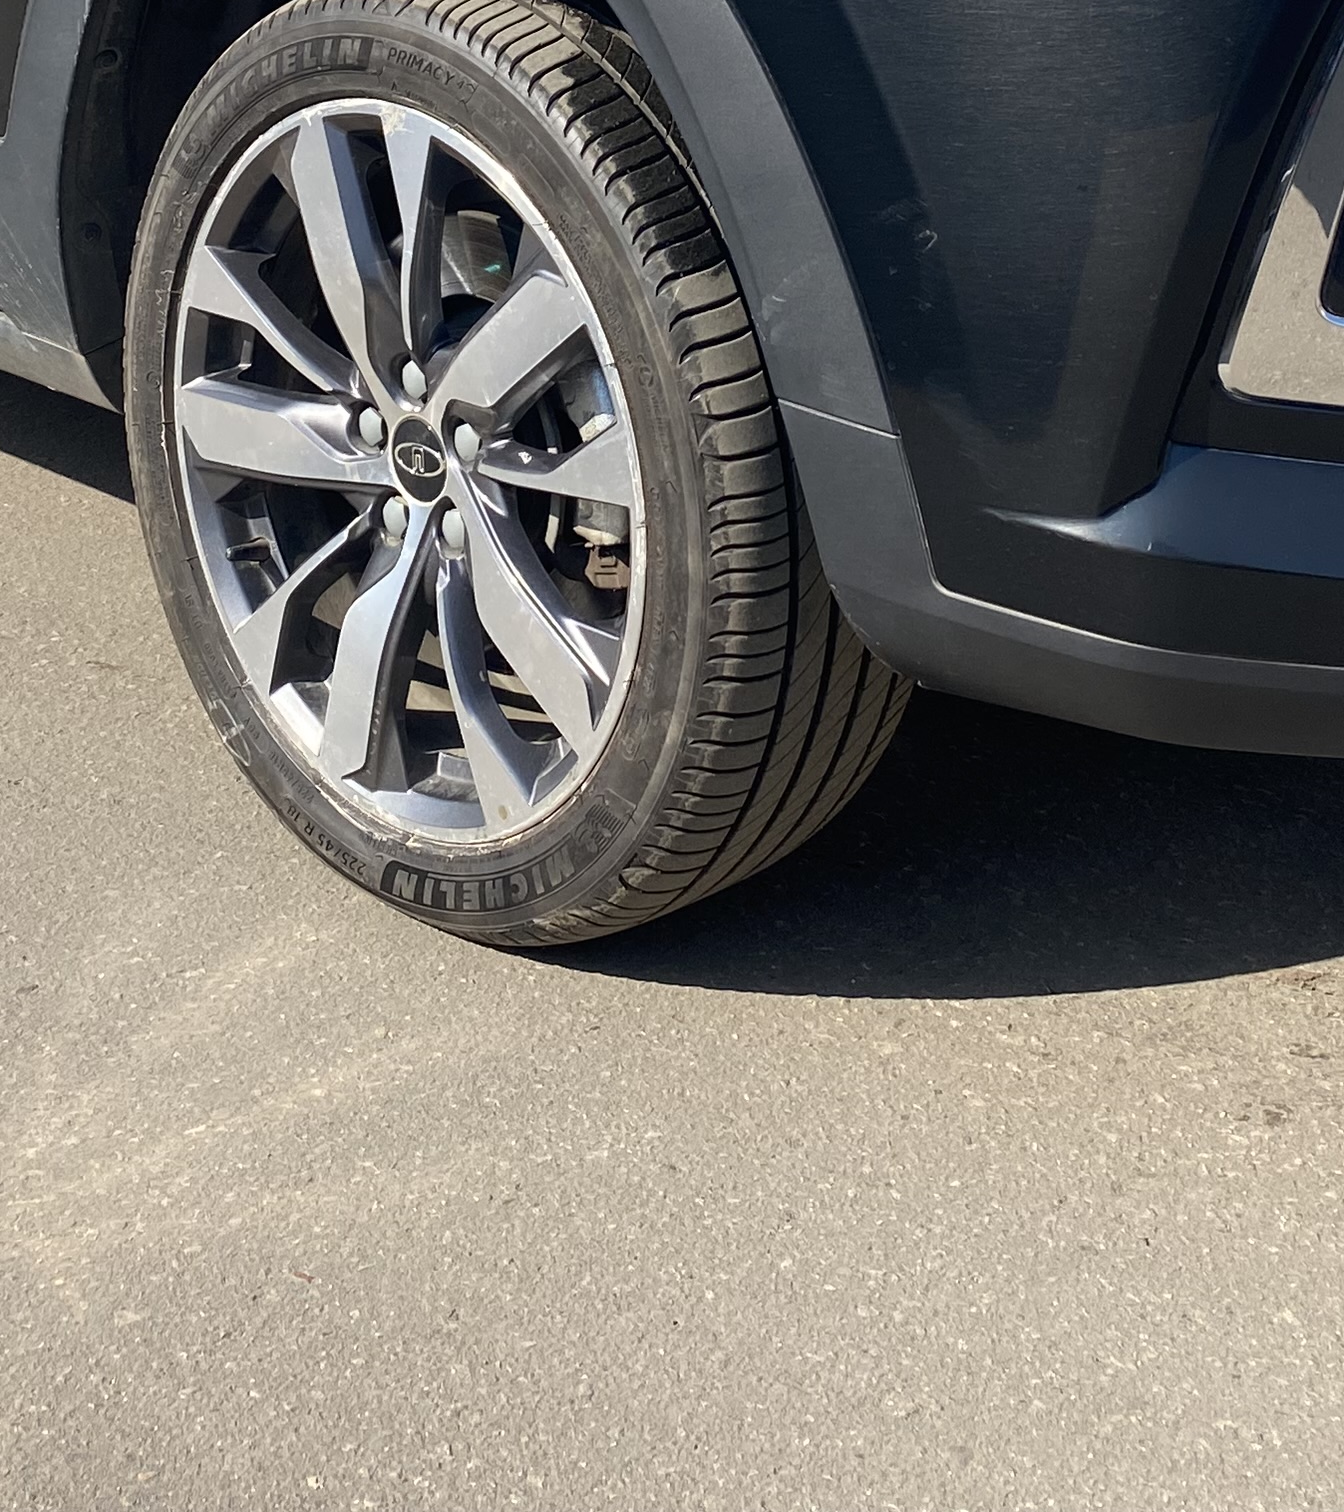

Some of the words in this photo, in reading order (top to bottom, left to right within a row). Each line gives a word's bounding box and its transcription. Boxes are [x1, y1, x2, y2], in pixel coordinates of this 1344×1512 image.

[386, 47, 456, 86] PRIMACY
[287, 804, 302, 822] 18
[303, 820, 315, 837] R
[317, 834, 367, 876] 225/45
[391, 845, 578, 911] MICHELIN
